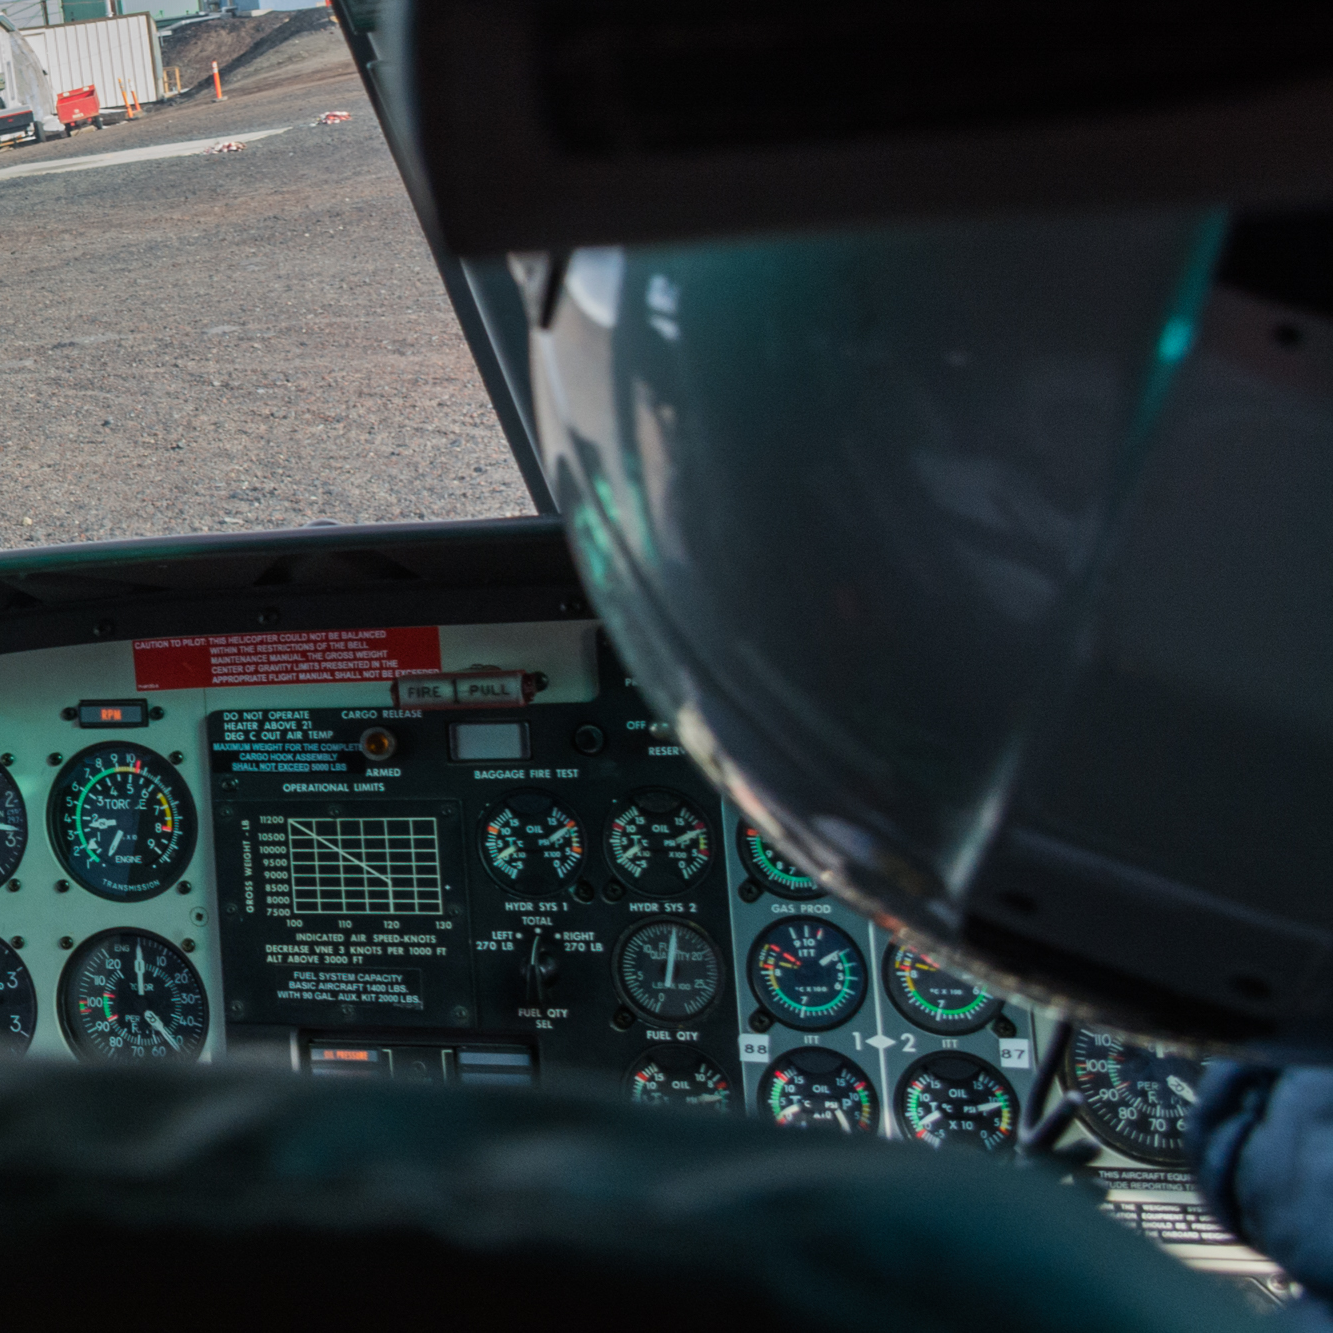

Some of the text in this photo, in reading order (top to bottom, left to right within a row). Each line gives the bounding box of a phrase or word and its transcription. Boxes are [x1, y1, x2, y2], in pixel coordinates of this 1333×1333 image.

[135, 641, 169, 649] CAUTION
[183, 638, 207, 646] PILOT:
[228, 635, 278, 643] HELICOPTER
[280, 633, 307, 641] COULD
[310, 632, 325, 640] NOT
[342, 630, 386, 639] BALANCED
[257, 642, 315, 652] RESTRICTIONS
[330, 641, 345, 649] THE
[211, 655, 267, 664] MAINTENANCE
[270, 653, 305, 661] MANUAL.
[307, 652, 323, 660] THE
[356, 650, 388, 658] WEIGHT
[212, 666, 243, 674] CENTER
[258, 663, 291, 672] GRAVITY
[293, 662, 319, 670] LIMITS
[321, 660, 370, 669] PRESENTED
[372, 660, 380, 668] IN
[408, 687, 441, 698] FIRE
[470, 684, 509, 696] PULL
[101, 709, 121, 720] RPM
[224, 711, 310, 720] DO NOT OPERATE
[342, 710, 422, 719] CARGO RELEASE
[224, 721, 312, 730] HEATER ABOVE 21
[225, 730, 333, 740] DEG C OUT AIR TEMP
[213, 743, 251, 751] MAXIMUM
[252, 743, 283, 751] WEIGHT
[285, 743, 301, 751] FOR
[302, 743, 318, 751] THE
[239, 753, 338, 761] CARGO HOOK ASSEMBLY
[232, 763, 255, 771] SHALL
[257, 763, 275, 772] NOT
[277, 763, 310, 772] EXCEED
[311, 763, 329, 771] 5000
[366, 769, 401, 777] ARMED
[474, 769, 579, 779] BAGGAGE FIRE TEST
[283, 783, 384, 792] OPERATIONAL LIMITS
[260, 816, 284, 824] 11200
[258, 833, 285, 841] 10500
[260, 846, 287, 854] 10000
[241, 819, 254, 913] GROSS WEIGHT LB
[102, 879, 159, 891] TRANSMISSION
[265, 884, 289, 892] 8500
[505, 903, 568, 912] HYDR SYS 1
[630, 903, 697, 912] HYDR SYS 2
[771, 905, 831, 913] GAS PROD
[436, 921, 452, 929] 130
[522, 917, 553, 925] TOTAL
[296, 933, 436, 943] INDICATED AIR SPEED-KNOTS
[492, 932, 512, 940] LEFT
[563, 932, 595, 941] RIGHT
[266, 945, 309, 953] DECREASE
[339, 946, 344, 954] 3
[350, 947, 382, 955] KNOTS
[387, 947, 404, 955] PER
[409, 947, 431, 955] 1000
[476, 942, 514, 951] 270 LB
[565, 943, 603, 951] 270 LB
[798, 949, 815, 957] ITT
[324, 956, 347, 964] 3000
[294, 972, 403, 983] FUEL SYSTEM CAPACITY
[289, 981, 409, 993] BASIC AIRCRAFT 1400 LBS.
[277, 991, 300, 999] WITH
[315, 992, 336, 1000] GAL.
[338, 993, 359, 1001] AUX.
[362, 993, 376, 1001] KIT
[378, 994, 398, 1002] 2000
[400, 995, 420, 1003] LBS.
[518, 1009, 568, 1018] FUEL QTY
[536, 1020, 553, 1028] SEL
[646, 1031, 698, 1041] FUEL QTY
[804, 1036, 819, 1044] ITT
[852, 1032, 861, 1050] 1
[901, 1033, 916, 1052] 2
[942, 1040, 958, 1048] ITT
[745, 1044, 767, 1054] 88
[1001, 1049, 1025, 1059] 87
